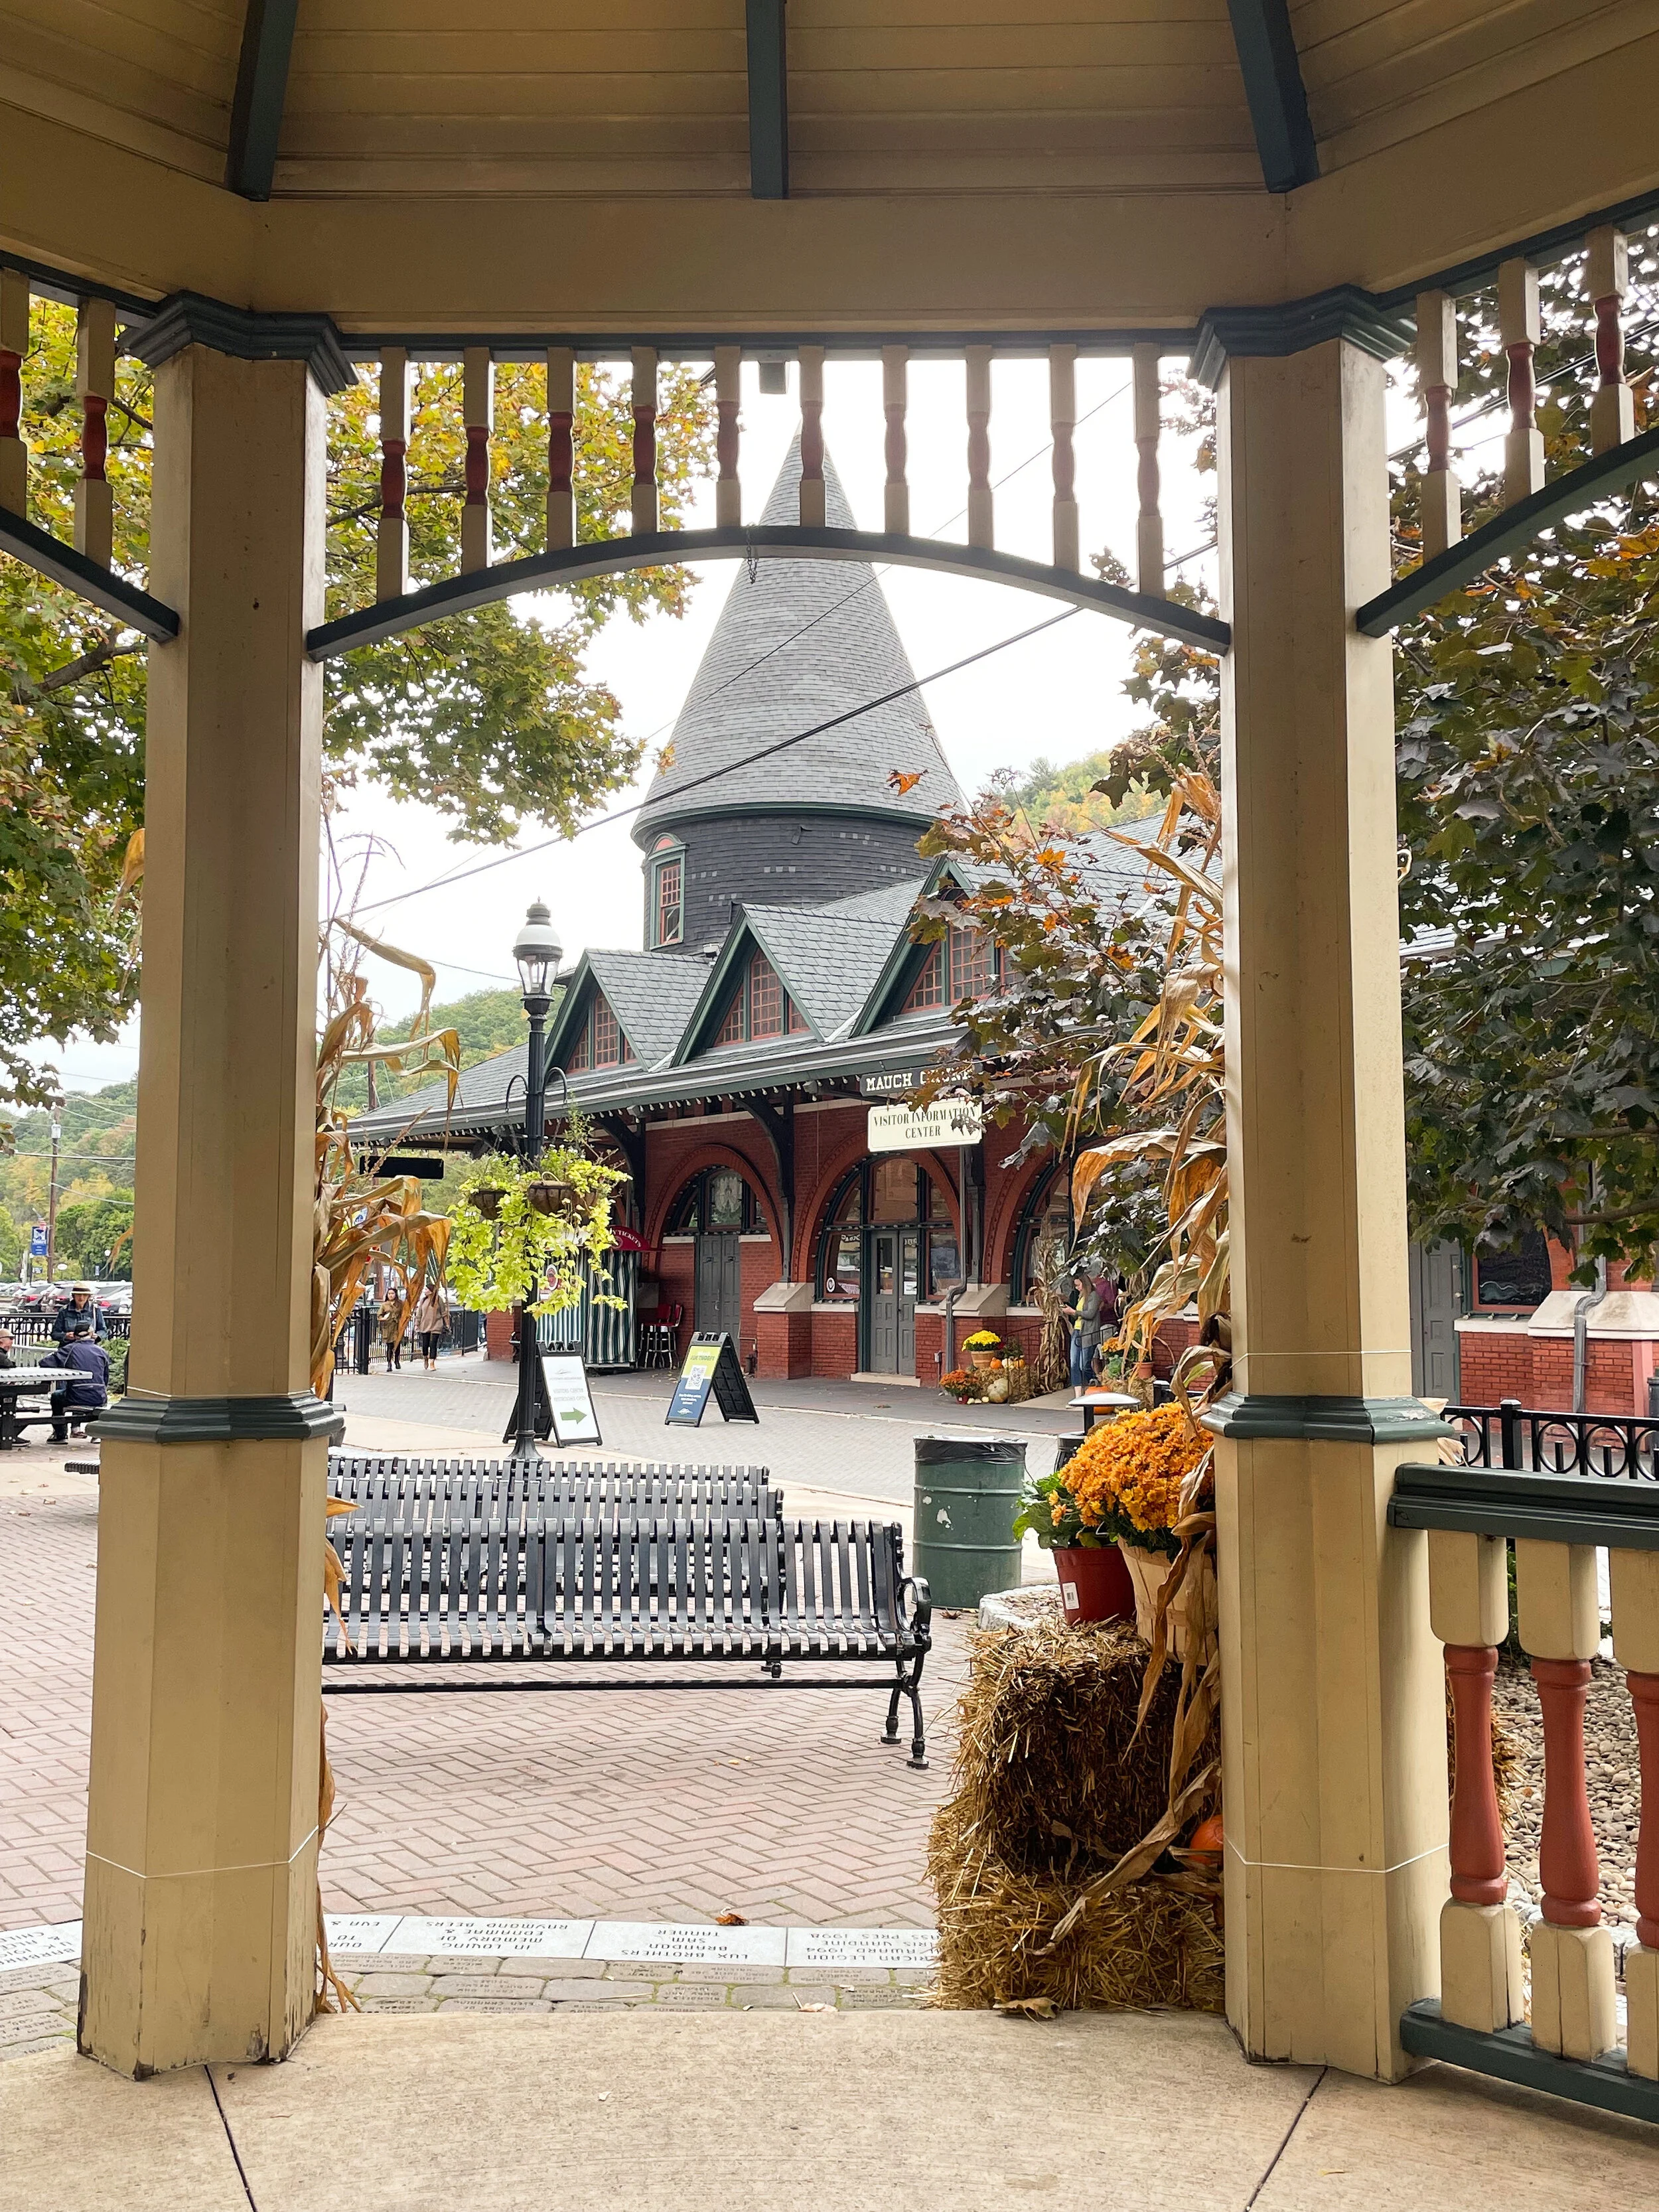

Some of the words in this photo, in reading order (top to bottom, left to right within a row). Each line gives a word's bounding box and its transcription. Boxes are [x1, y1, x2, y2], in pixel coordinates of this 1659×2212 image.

[865, 1072, 913, 1092] MAUCH
[873, 1113, 910, 1127] VISITOR
[911, 1106, 976, 1124] INFORMATION
[905, 1125, 941, 1139] CENTER
[617, 1229, 642, 1248] TICKETS
[621, 1949, 705, 1958] BROTHERS
